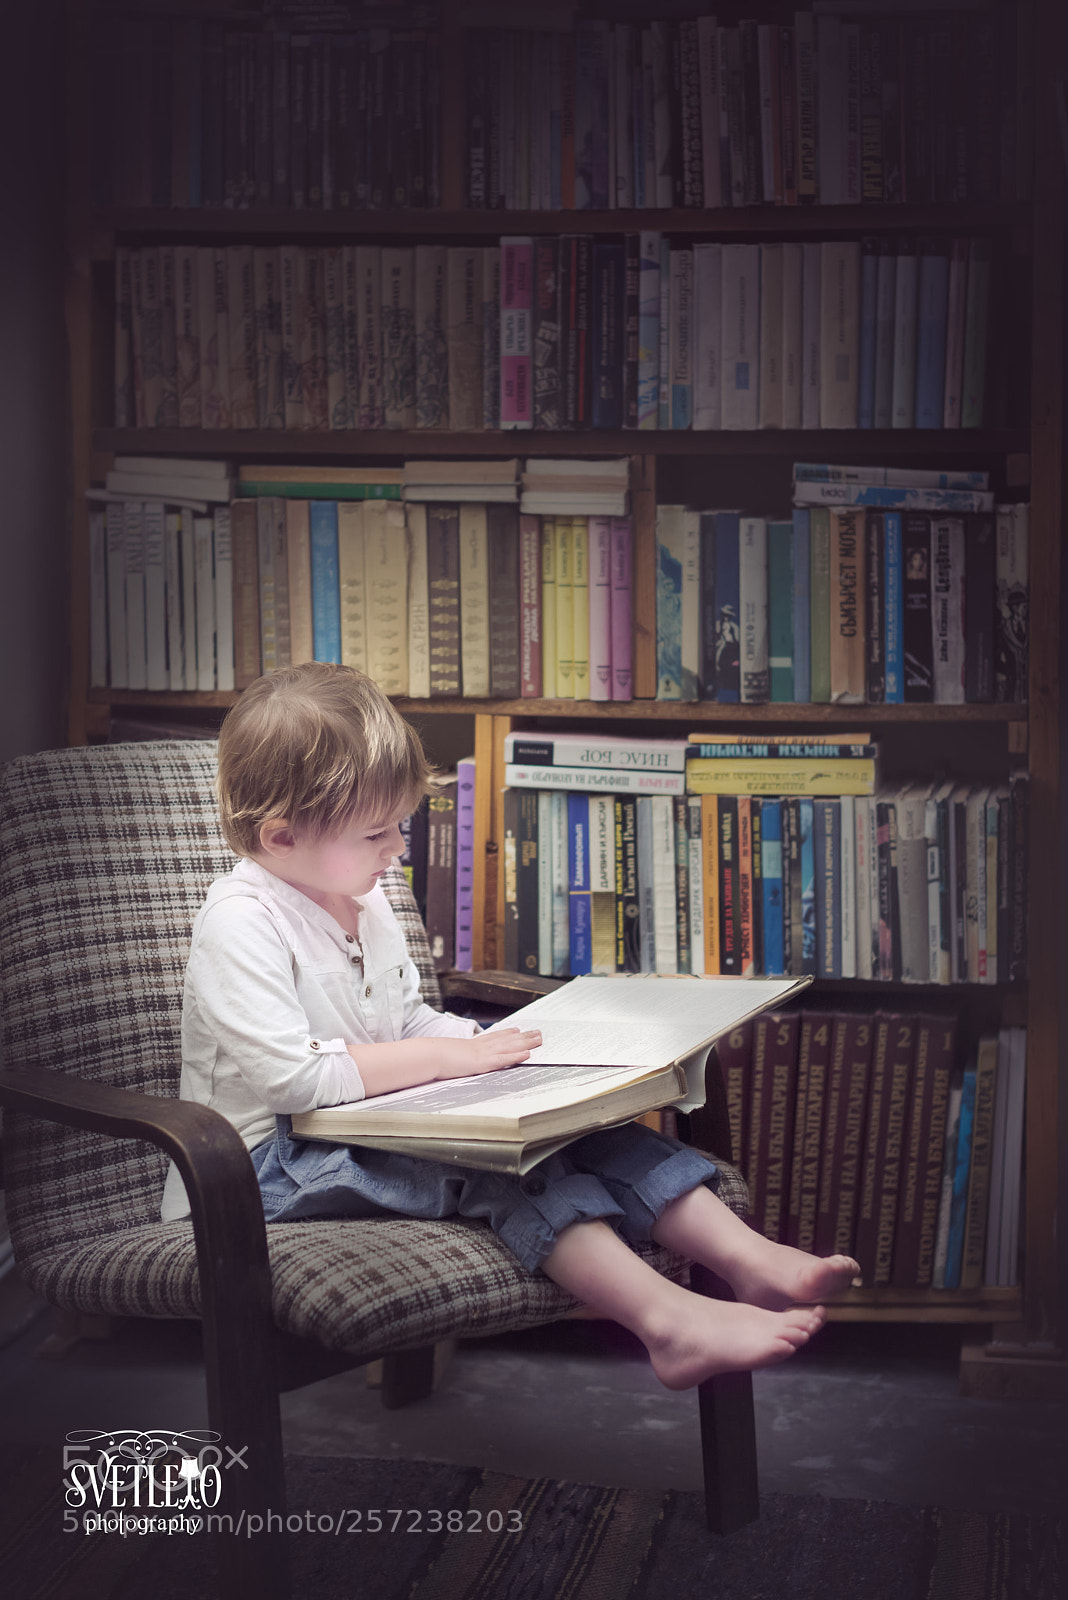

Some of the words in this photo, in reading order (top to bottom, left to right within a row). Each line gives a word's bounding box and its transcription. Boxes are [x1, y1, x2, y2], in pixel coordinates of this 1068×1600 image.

[801, 143, 812, 181] АРТЪР
[675, 315, 689, 381] Големите
[838, 514, 857, 559] МОЪМ
[839, 563, 857, 638] СЪМЪРСЕТ
[523, 607, 531, 681] АЛЕКСАНДЪР
[580, 750, 612, 764] БОР
[620, 751, 669, 768] НИЛС
[700, 744, 768, 758] ИСТОРИИ
[777, 744, 841, 757] МОРСКИ
[532, 771, 573, 785] ЛЕОНАРДО
[575, 774, 585, 785] НА
[588, 775, 630, 788] ШИФЪРЪТ
[598, 801, 607, 840] ХЪКСЛИ
[599, 839, 607, 848] И
[600, 849, 609, 889] ДАРВИН
[691, 841, 700, 885] ФОРСАЙТ
[692, 889, 702, 936] ФРЕДЕРИК
[726, 908, 733, 918] ЗА
[726, 920, 734, 953] ТРУДЕН
[728, 1028, 744, 1049] 6
[776, 1024, 791, 1046] 5
[813, 1024, 828, 1046] 4
[856, 1025, 870, 1047] 3
[897, 1026, 911, 1048] 2
[943, 1032, 952, 1051] 1
[768, 1065, 789, 1158] БЪЛГАРИЯ
[804, 1064, 824, 1158] БЪЛГАРИЯ
[842, 1062, 866, 1154] БЪЛГАРИЯ
[885, 1063, 908, 1159] БЪЛГАРИЯ
[927, 1068, 949, 1163] БЪЛГАРИЯ
[766, 1162, 783, 1188] НА
[801, 1160, 818, 1188] НА
[840, 1157, 858, 1184] НА
[881, 1163, 900, 1189] НА
[924, 1166, 941, 1193] НА
[873, 1194, 897, 1284] ИСТОРИЯ
[917, 1198, 937, 1284] ИСТОРИЯ
